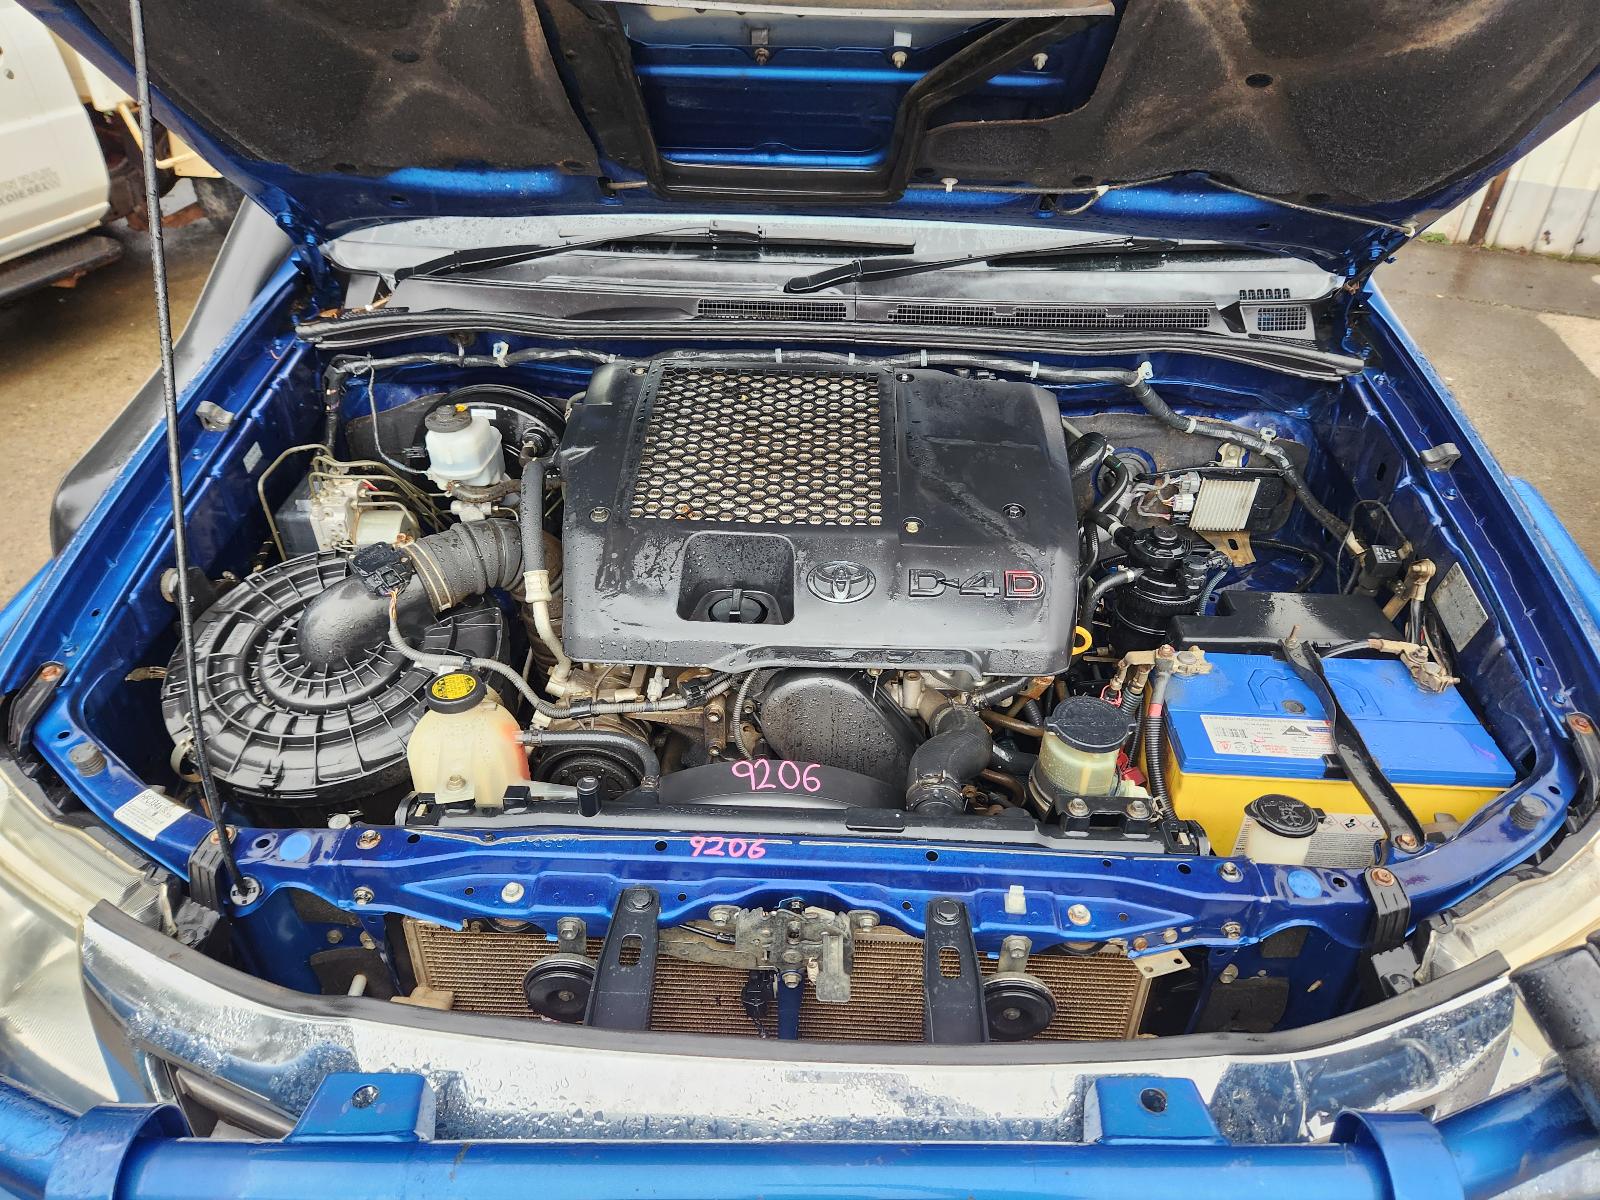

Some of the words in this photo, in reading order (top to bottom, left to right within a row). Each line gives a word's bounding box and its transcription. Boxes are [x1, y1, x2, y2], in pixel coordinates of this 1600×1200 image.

[909, 569, 1045, 600] D-4D
[731, 758, 821, 792] 9206
[690, 836, 766, 859] 9206
